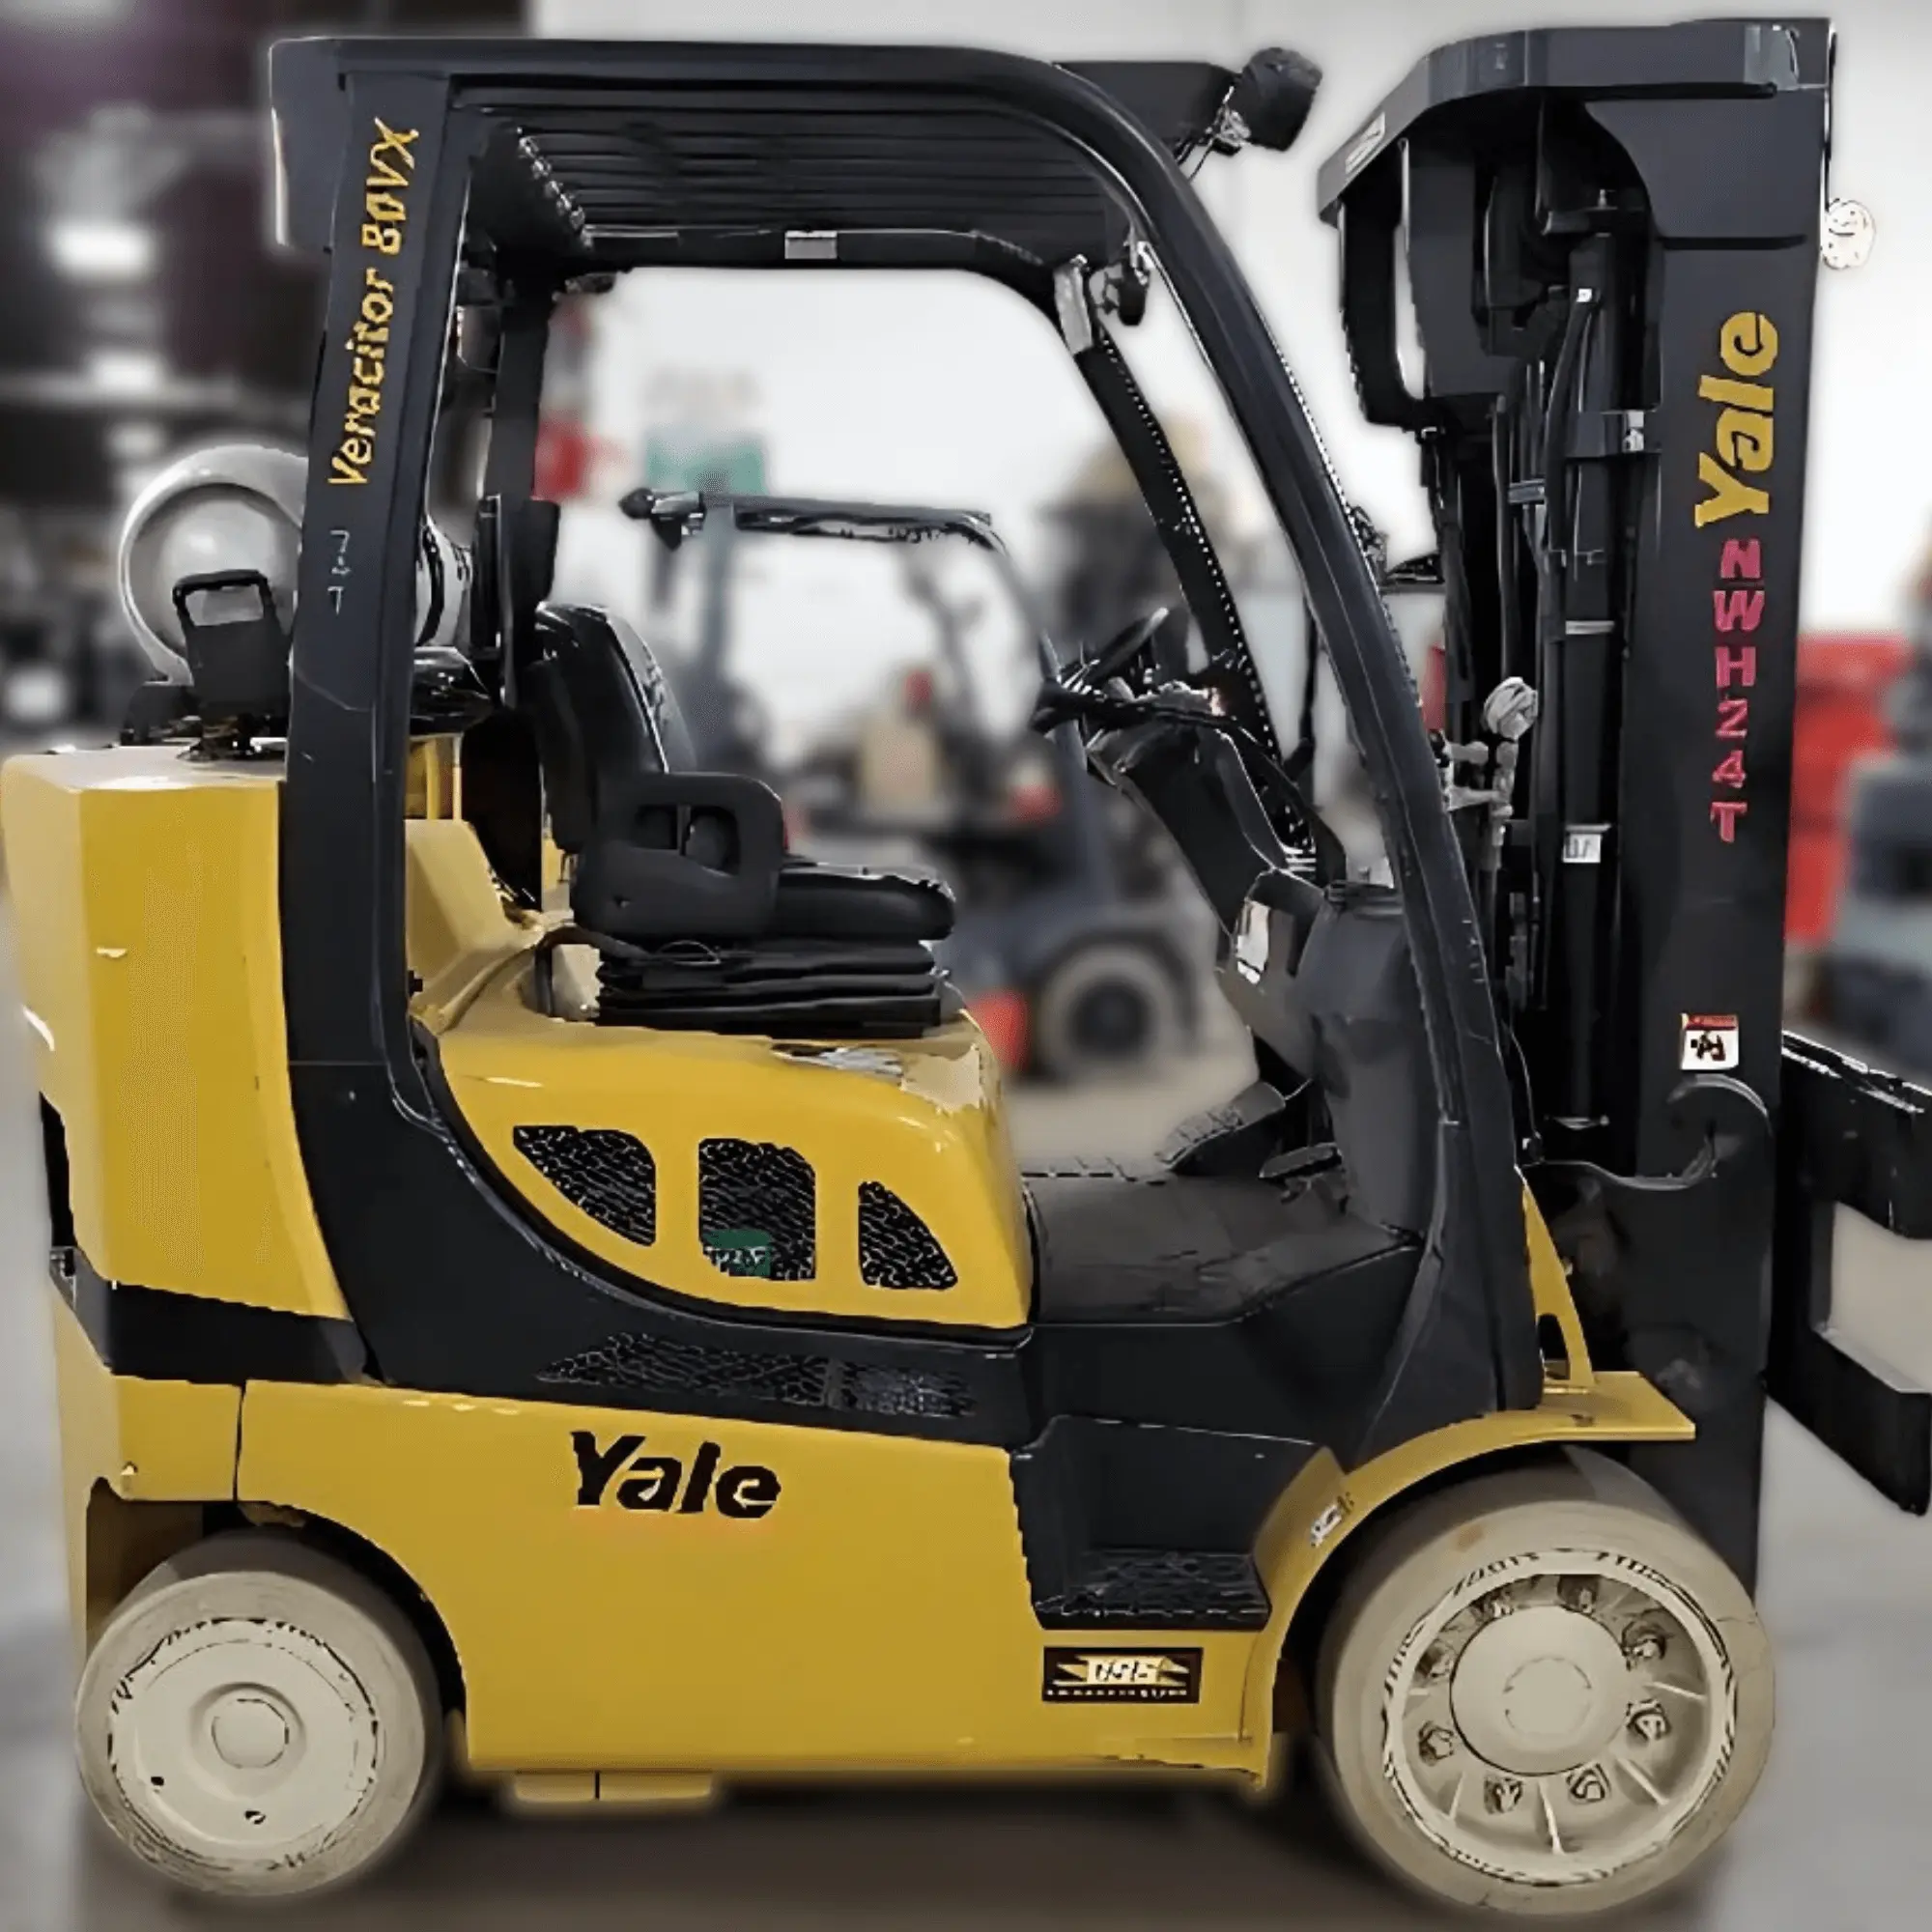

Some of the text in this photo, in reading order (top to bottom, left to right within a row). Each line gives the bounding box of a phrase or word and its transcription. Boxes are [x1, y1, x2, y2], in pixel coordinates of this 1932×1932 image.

[328, 268, 393, 485] Veracitor
[1694, 311, 1778, 527] Yale
[570, 1431, 781, 1519] Yale
